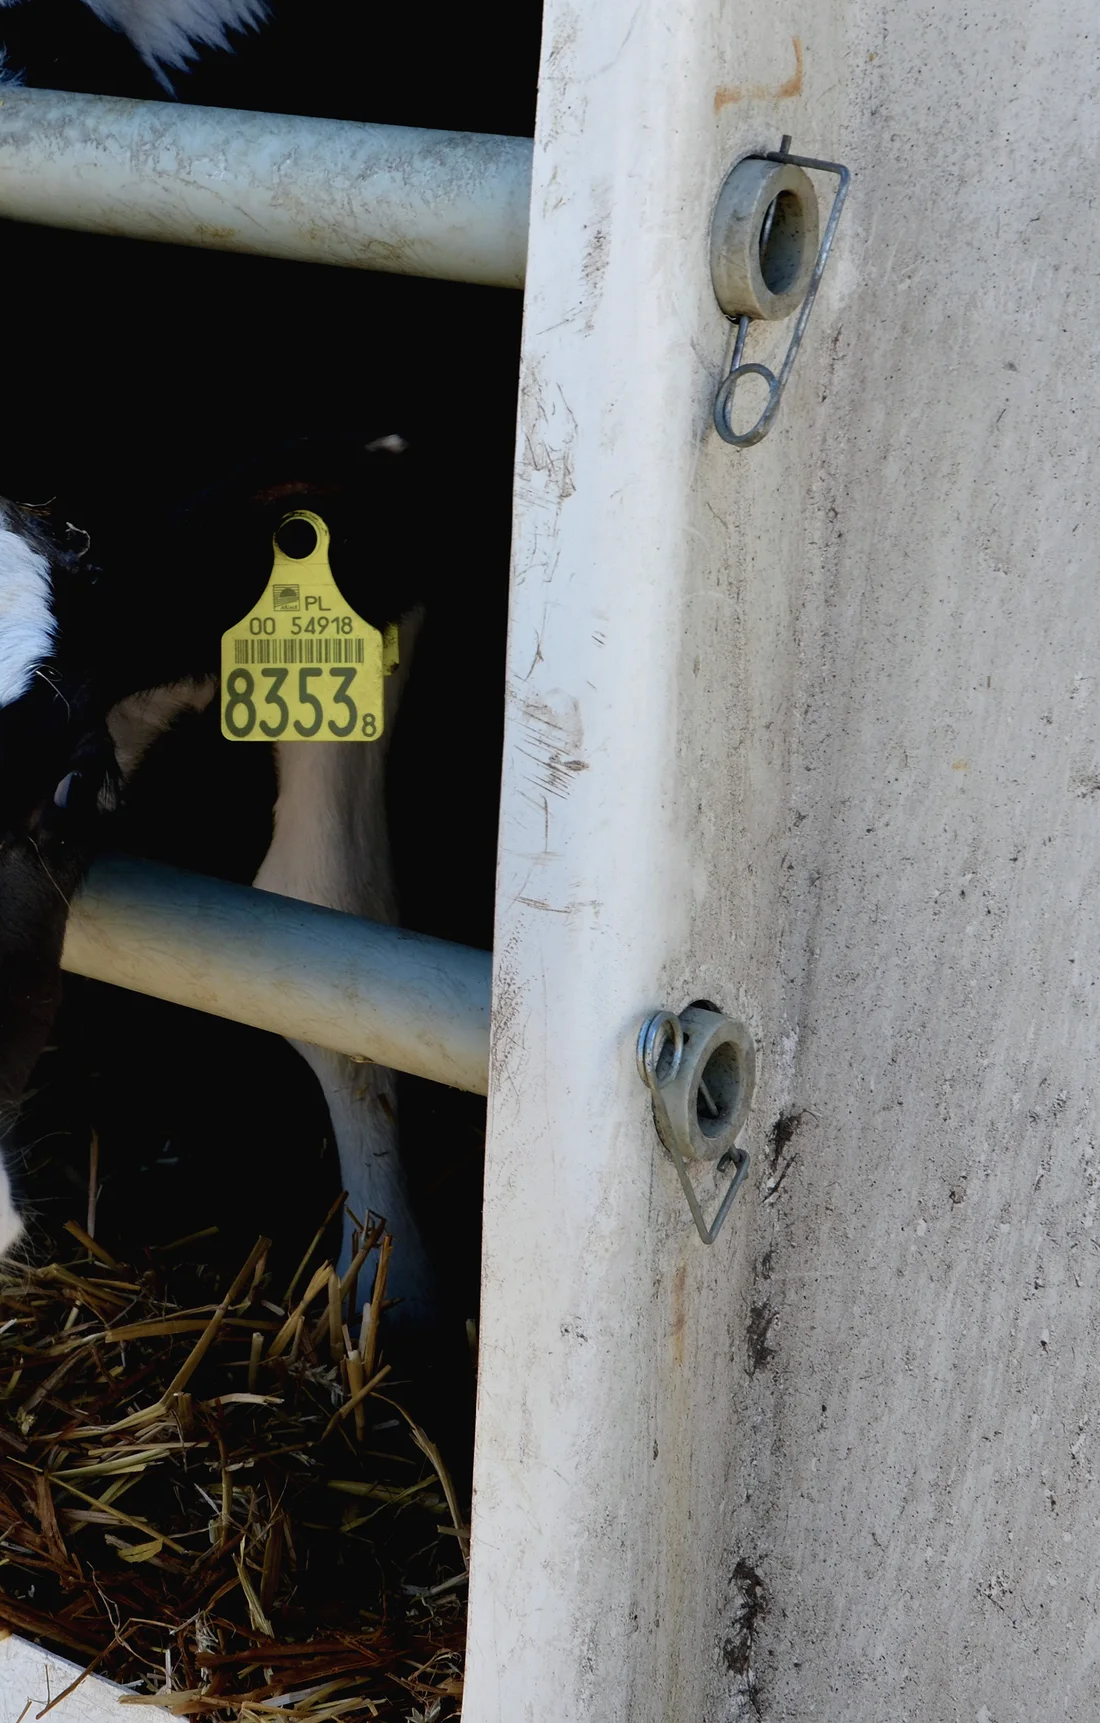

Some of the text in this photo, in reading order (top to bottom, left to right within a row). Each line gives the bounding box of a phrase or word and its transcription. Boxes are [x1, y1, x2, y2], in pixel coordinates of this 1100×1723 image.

[304, 595, 331, 611] PL
[290, 616, 353, 635] 54918
[224, 667, 377, 738] 8353 8
